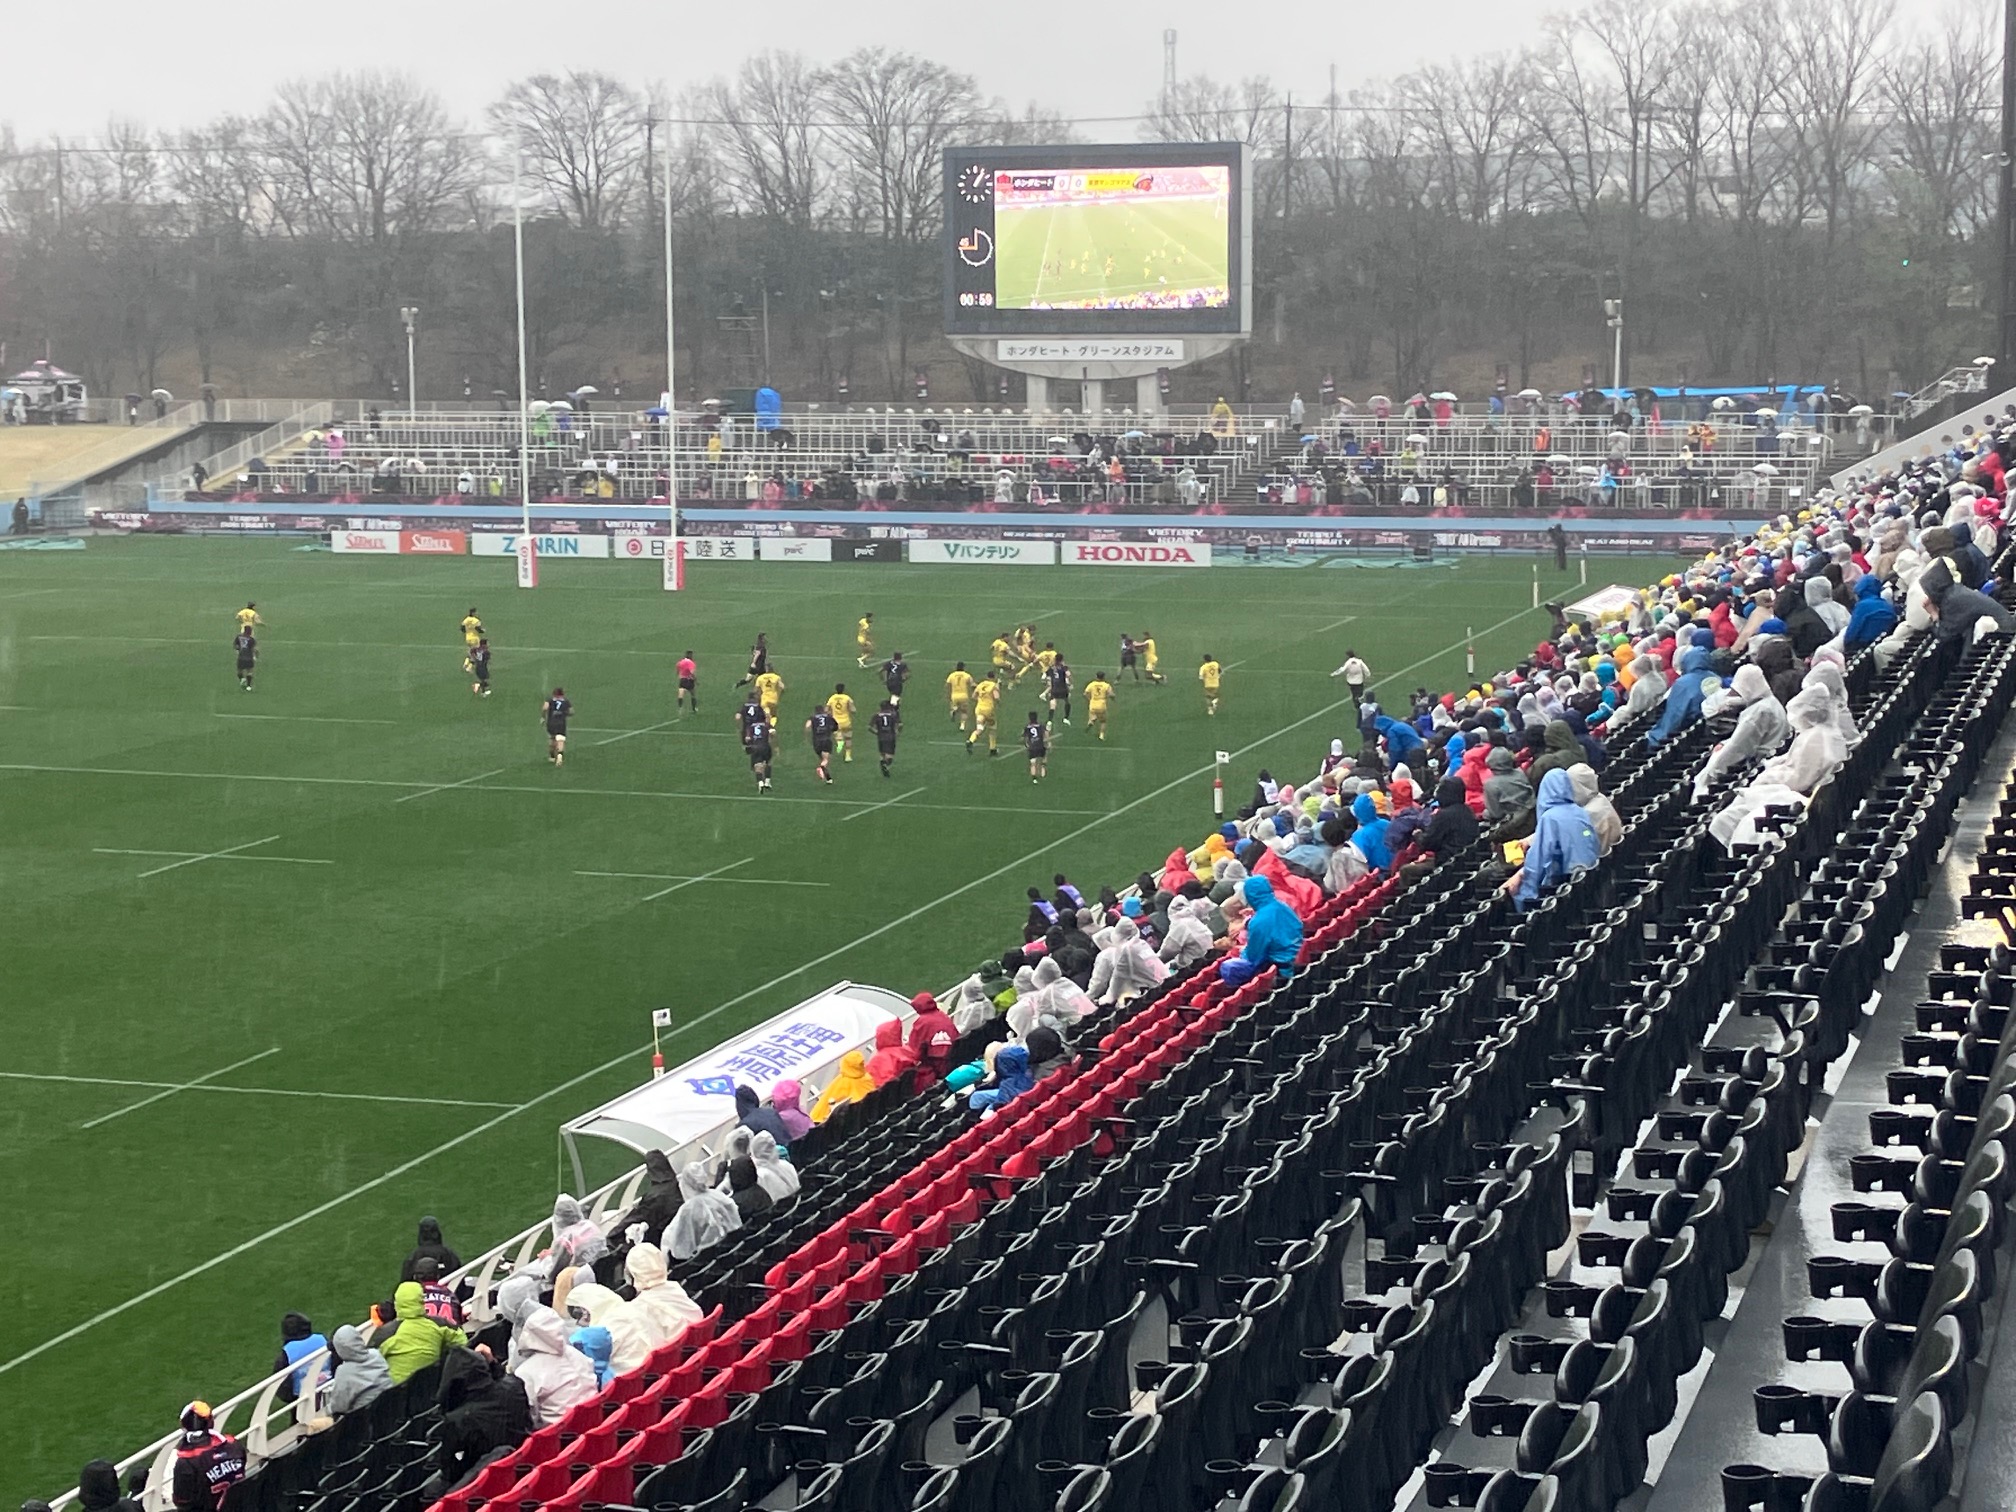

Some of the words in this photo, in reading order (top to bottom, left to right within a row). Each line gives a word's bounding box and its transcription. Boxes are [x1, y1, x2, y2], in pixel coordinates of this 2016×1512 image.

[1147, 528, 1204, 537] VICTORY
[502, 537, 578, 555] ZNRIN
[650, 539, 738, 559] 日陸送
[1077, 545, 1195, 563] HONDA
